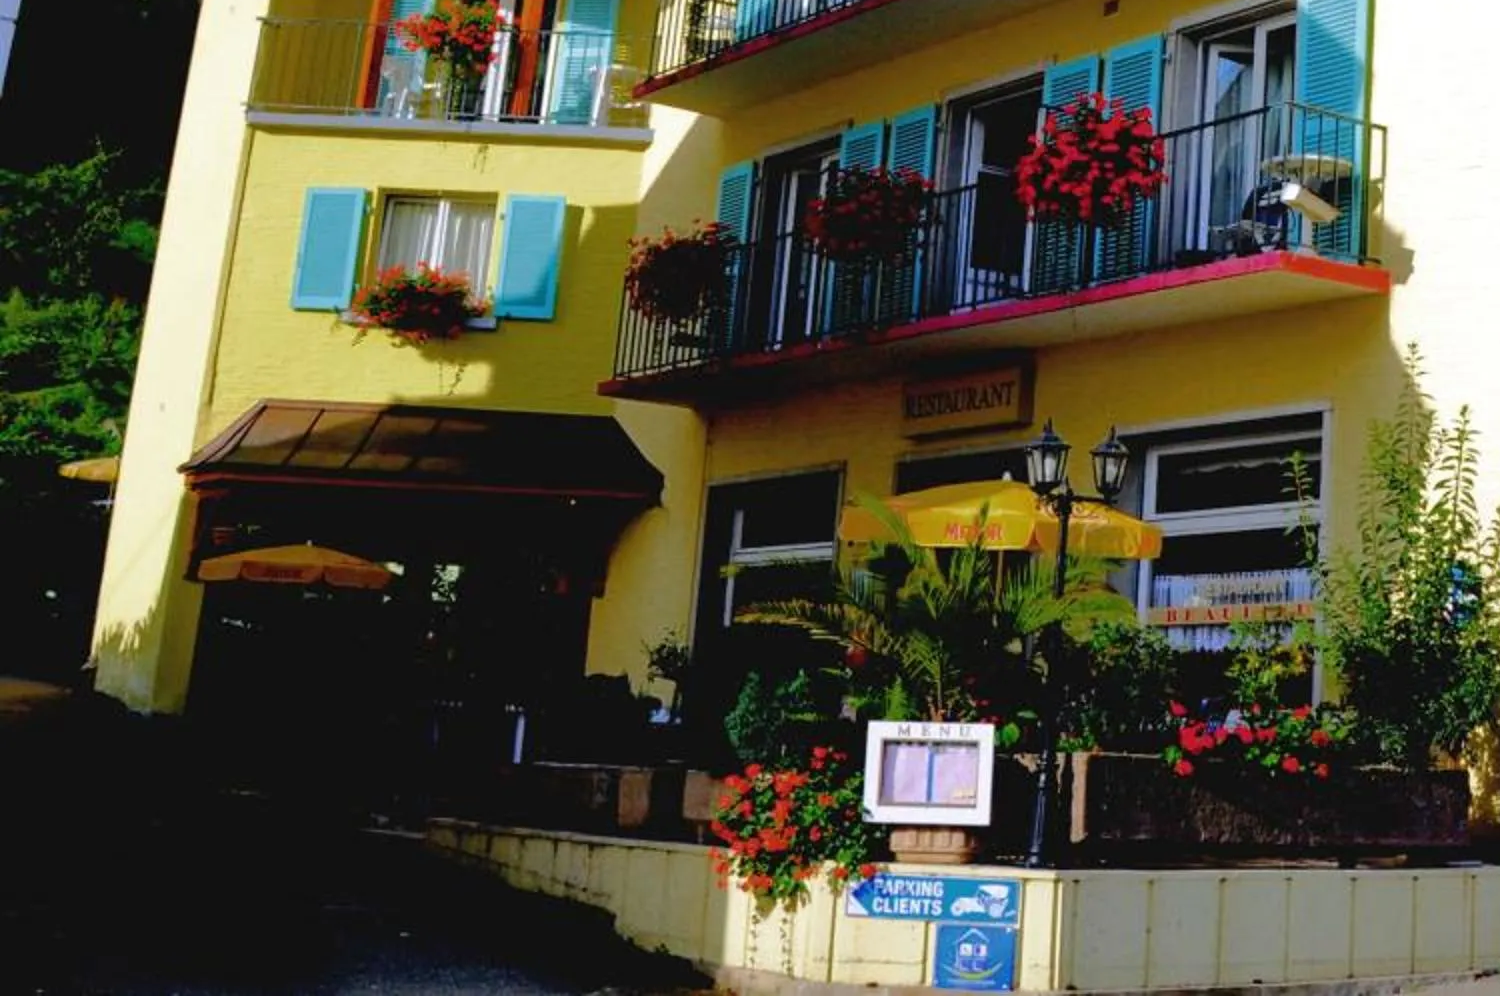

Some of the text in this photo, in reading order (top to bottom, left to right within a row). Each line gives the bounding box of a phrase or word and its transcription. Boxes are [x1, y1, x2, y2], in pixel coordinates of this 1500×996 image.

[905, 380, 1016, 419] RESTAURANT
[897, 723, 973, 737] MENU
[873, 878, 944, 898] PARKING
[872, 897, 943, 916] CLIENTS
